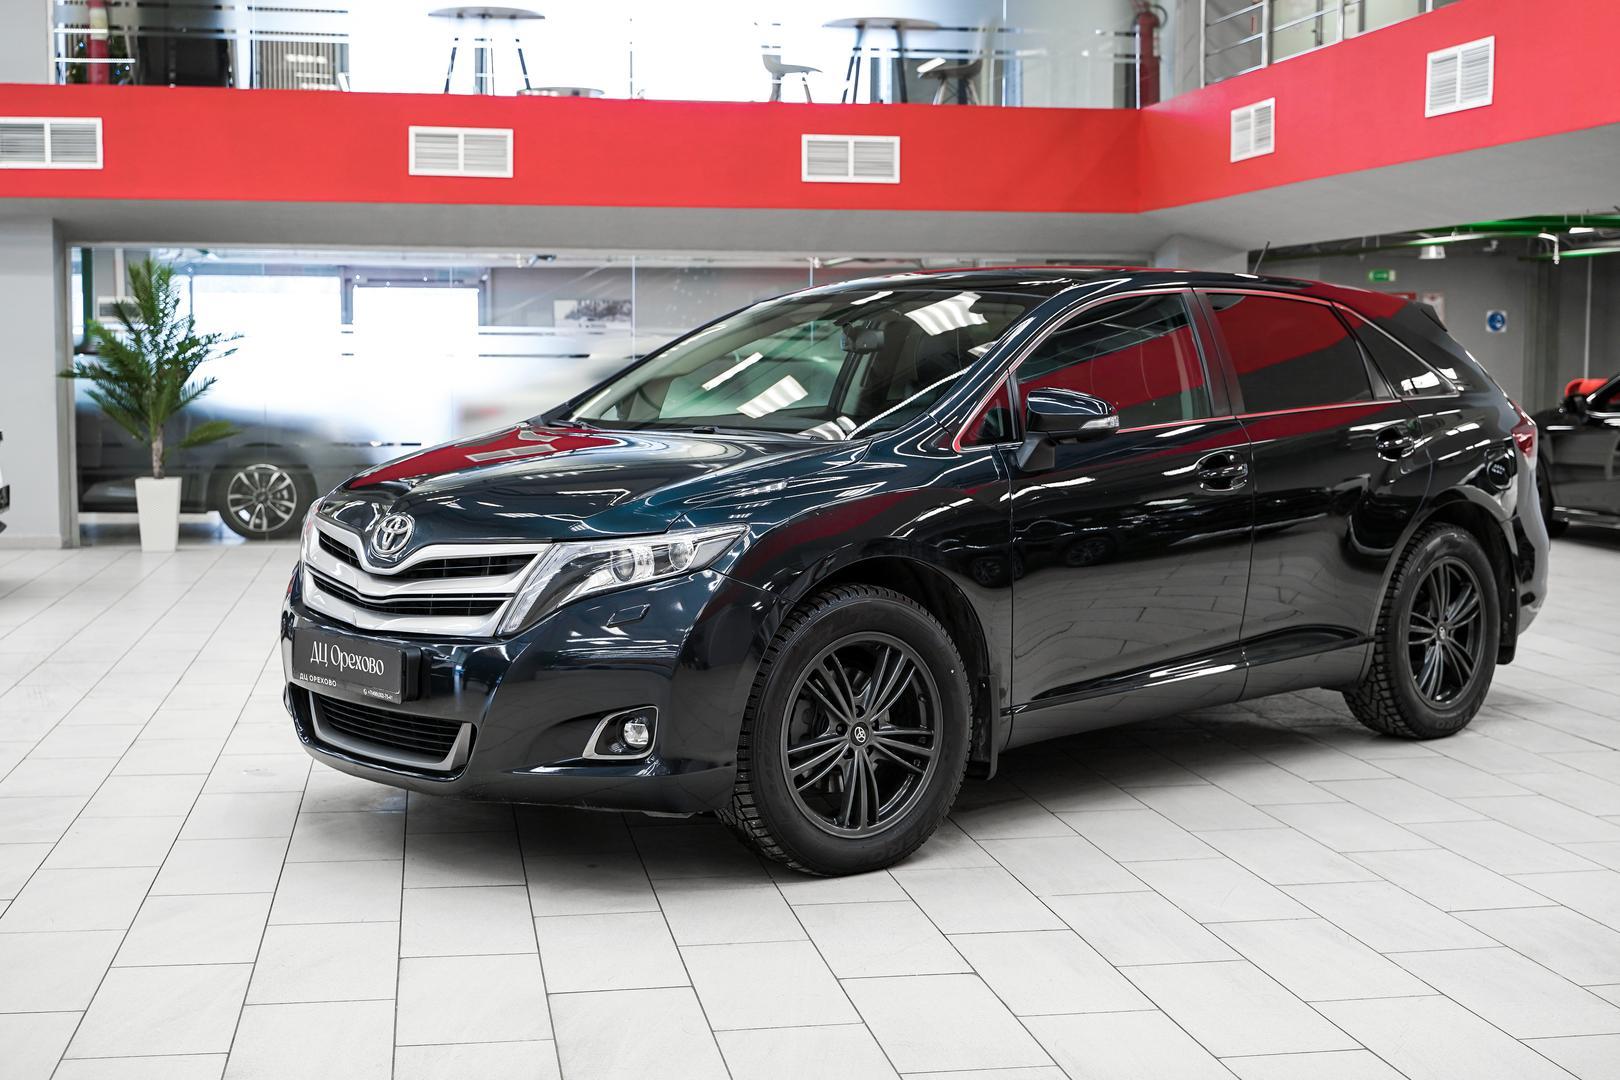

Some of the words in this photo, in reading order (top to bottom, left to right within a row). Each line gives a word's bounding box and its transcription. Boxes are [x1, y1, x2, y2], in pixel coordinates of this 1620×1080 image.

[310, 641, 328, 668] ДЦ
[330, 644, 385, 676] Орехово
[309, 675, 337, 687] ОРЕХОВО
